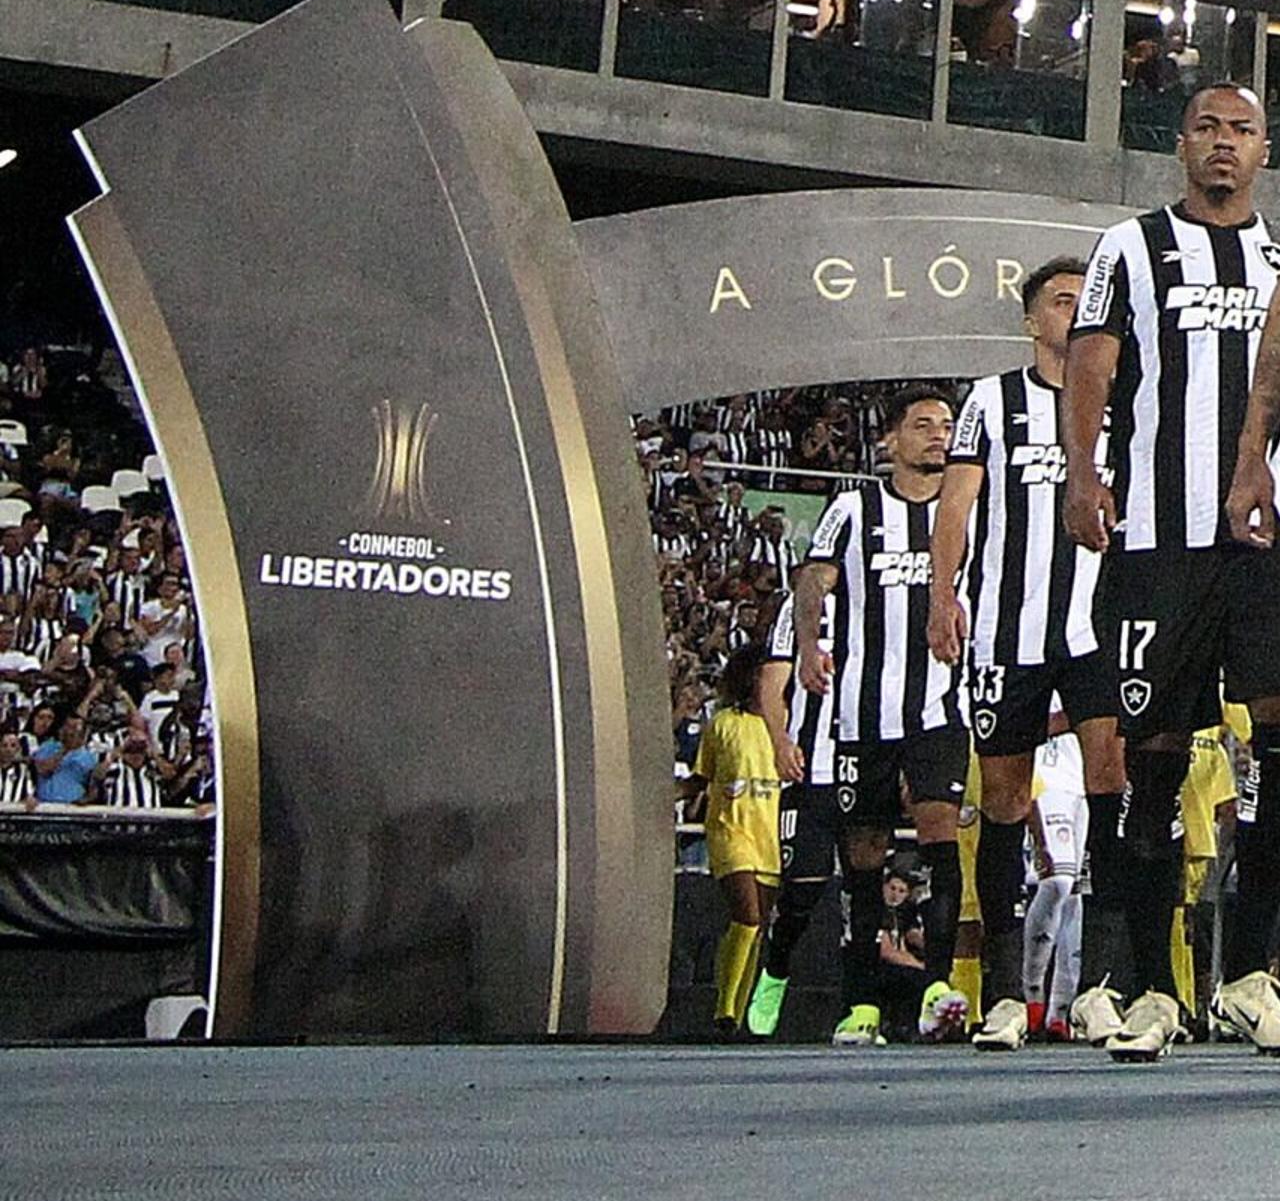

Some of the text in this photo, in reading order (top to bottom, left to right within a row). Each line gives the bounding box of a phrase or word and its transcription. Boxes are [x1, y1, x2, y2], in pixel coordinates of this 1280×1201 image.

[709, 267, 752, 314] A
[1080, 253, 1110, 323] Centrum
[1165, 285, 1258, 310] PARI
[349, 532, 436, 559] CONMEBOL
[260, 553, 512, 600] LIBERTADORES
[1119, 620, 1158, 671] 17
[972, 665, 1006, 705] 33
[838, 755, 860, 784] 26
